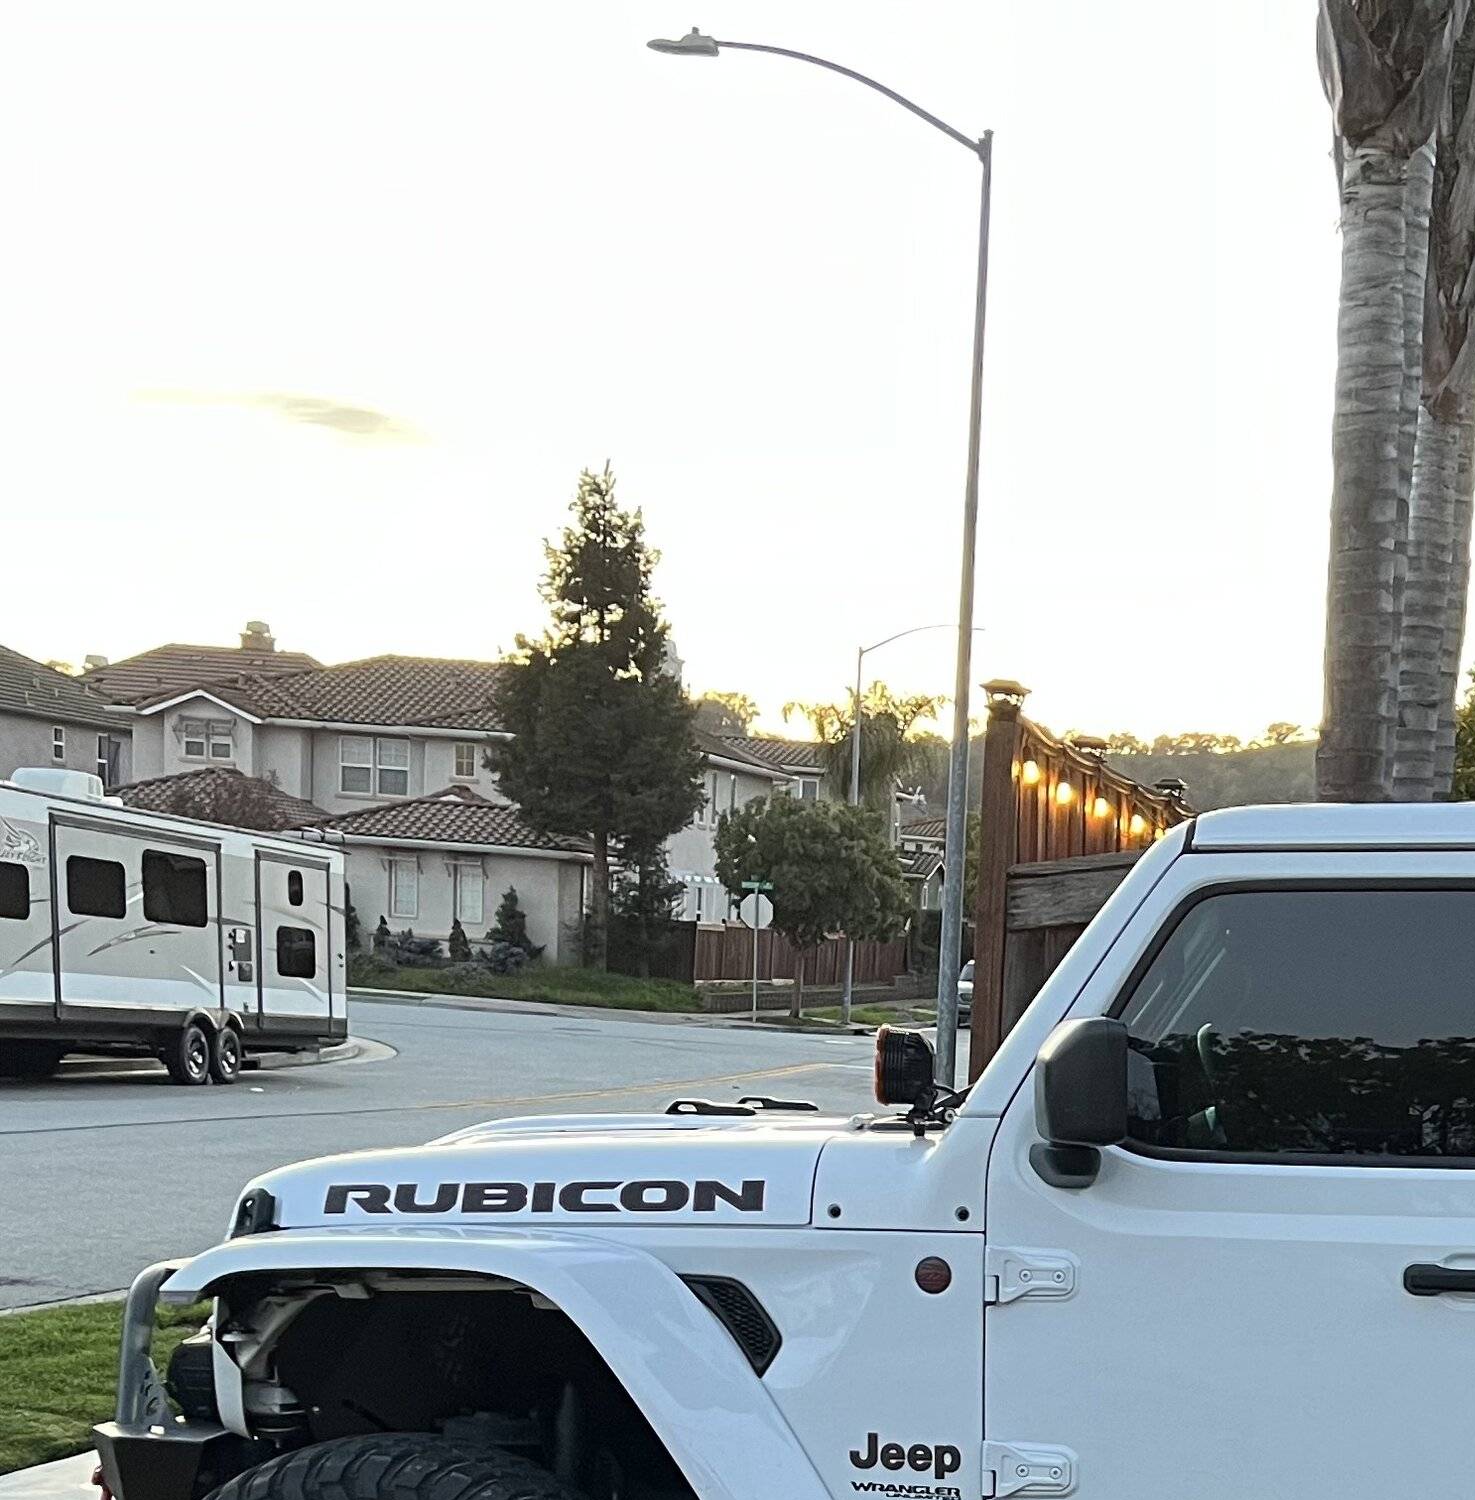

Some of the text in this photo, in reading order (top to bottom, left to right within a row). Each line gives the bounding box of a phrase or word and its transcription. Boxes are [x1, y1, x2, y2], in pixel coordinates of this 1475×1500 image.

[323, 1180, 765, 1214] RUBICON
[849, 1432, 961, 1479] Jeep
[850, 1481, 960, 1497] WRANGLER
